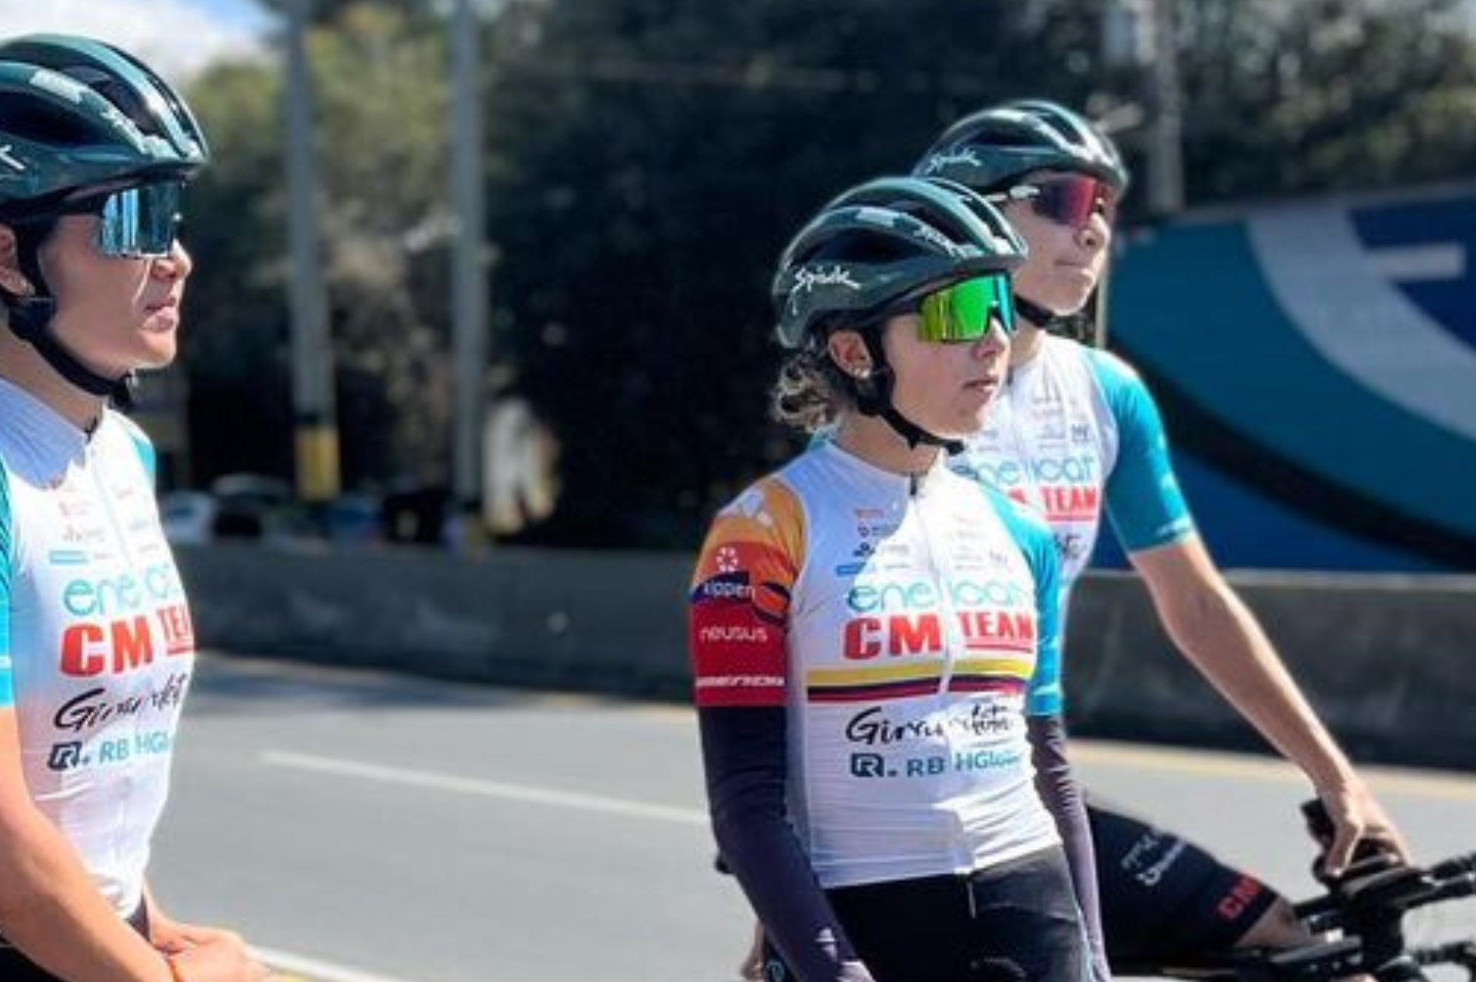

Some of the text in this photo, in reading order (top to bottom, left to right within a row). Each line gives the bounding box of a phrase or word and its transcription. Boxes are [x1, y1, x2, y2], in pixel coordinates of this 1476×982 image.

[59, 614, 154, 678] CM
[843, 612, 943, 660] CM
[906, 755, 945, 778] RB
